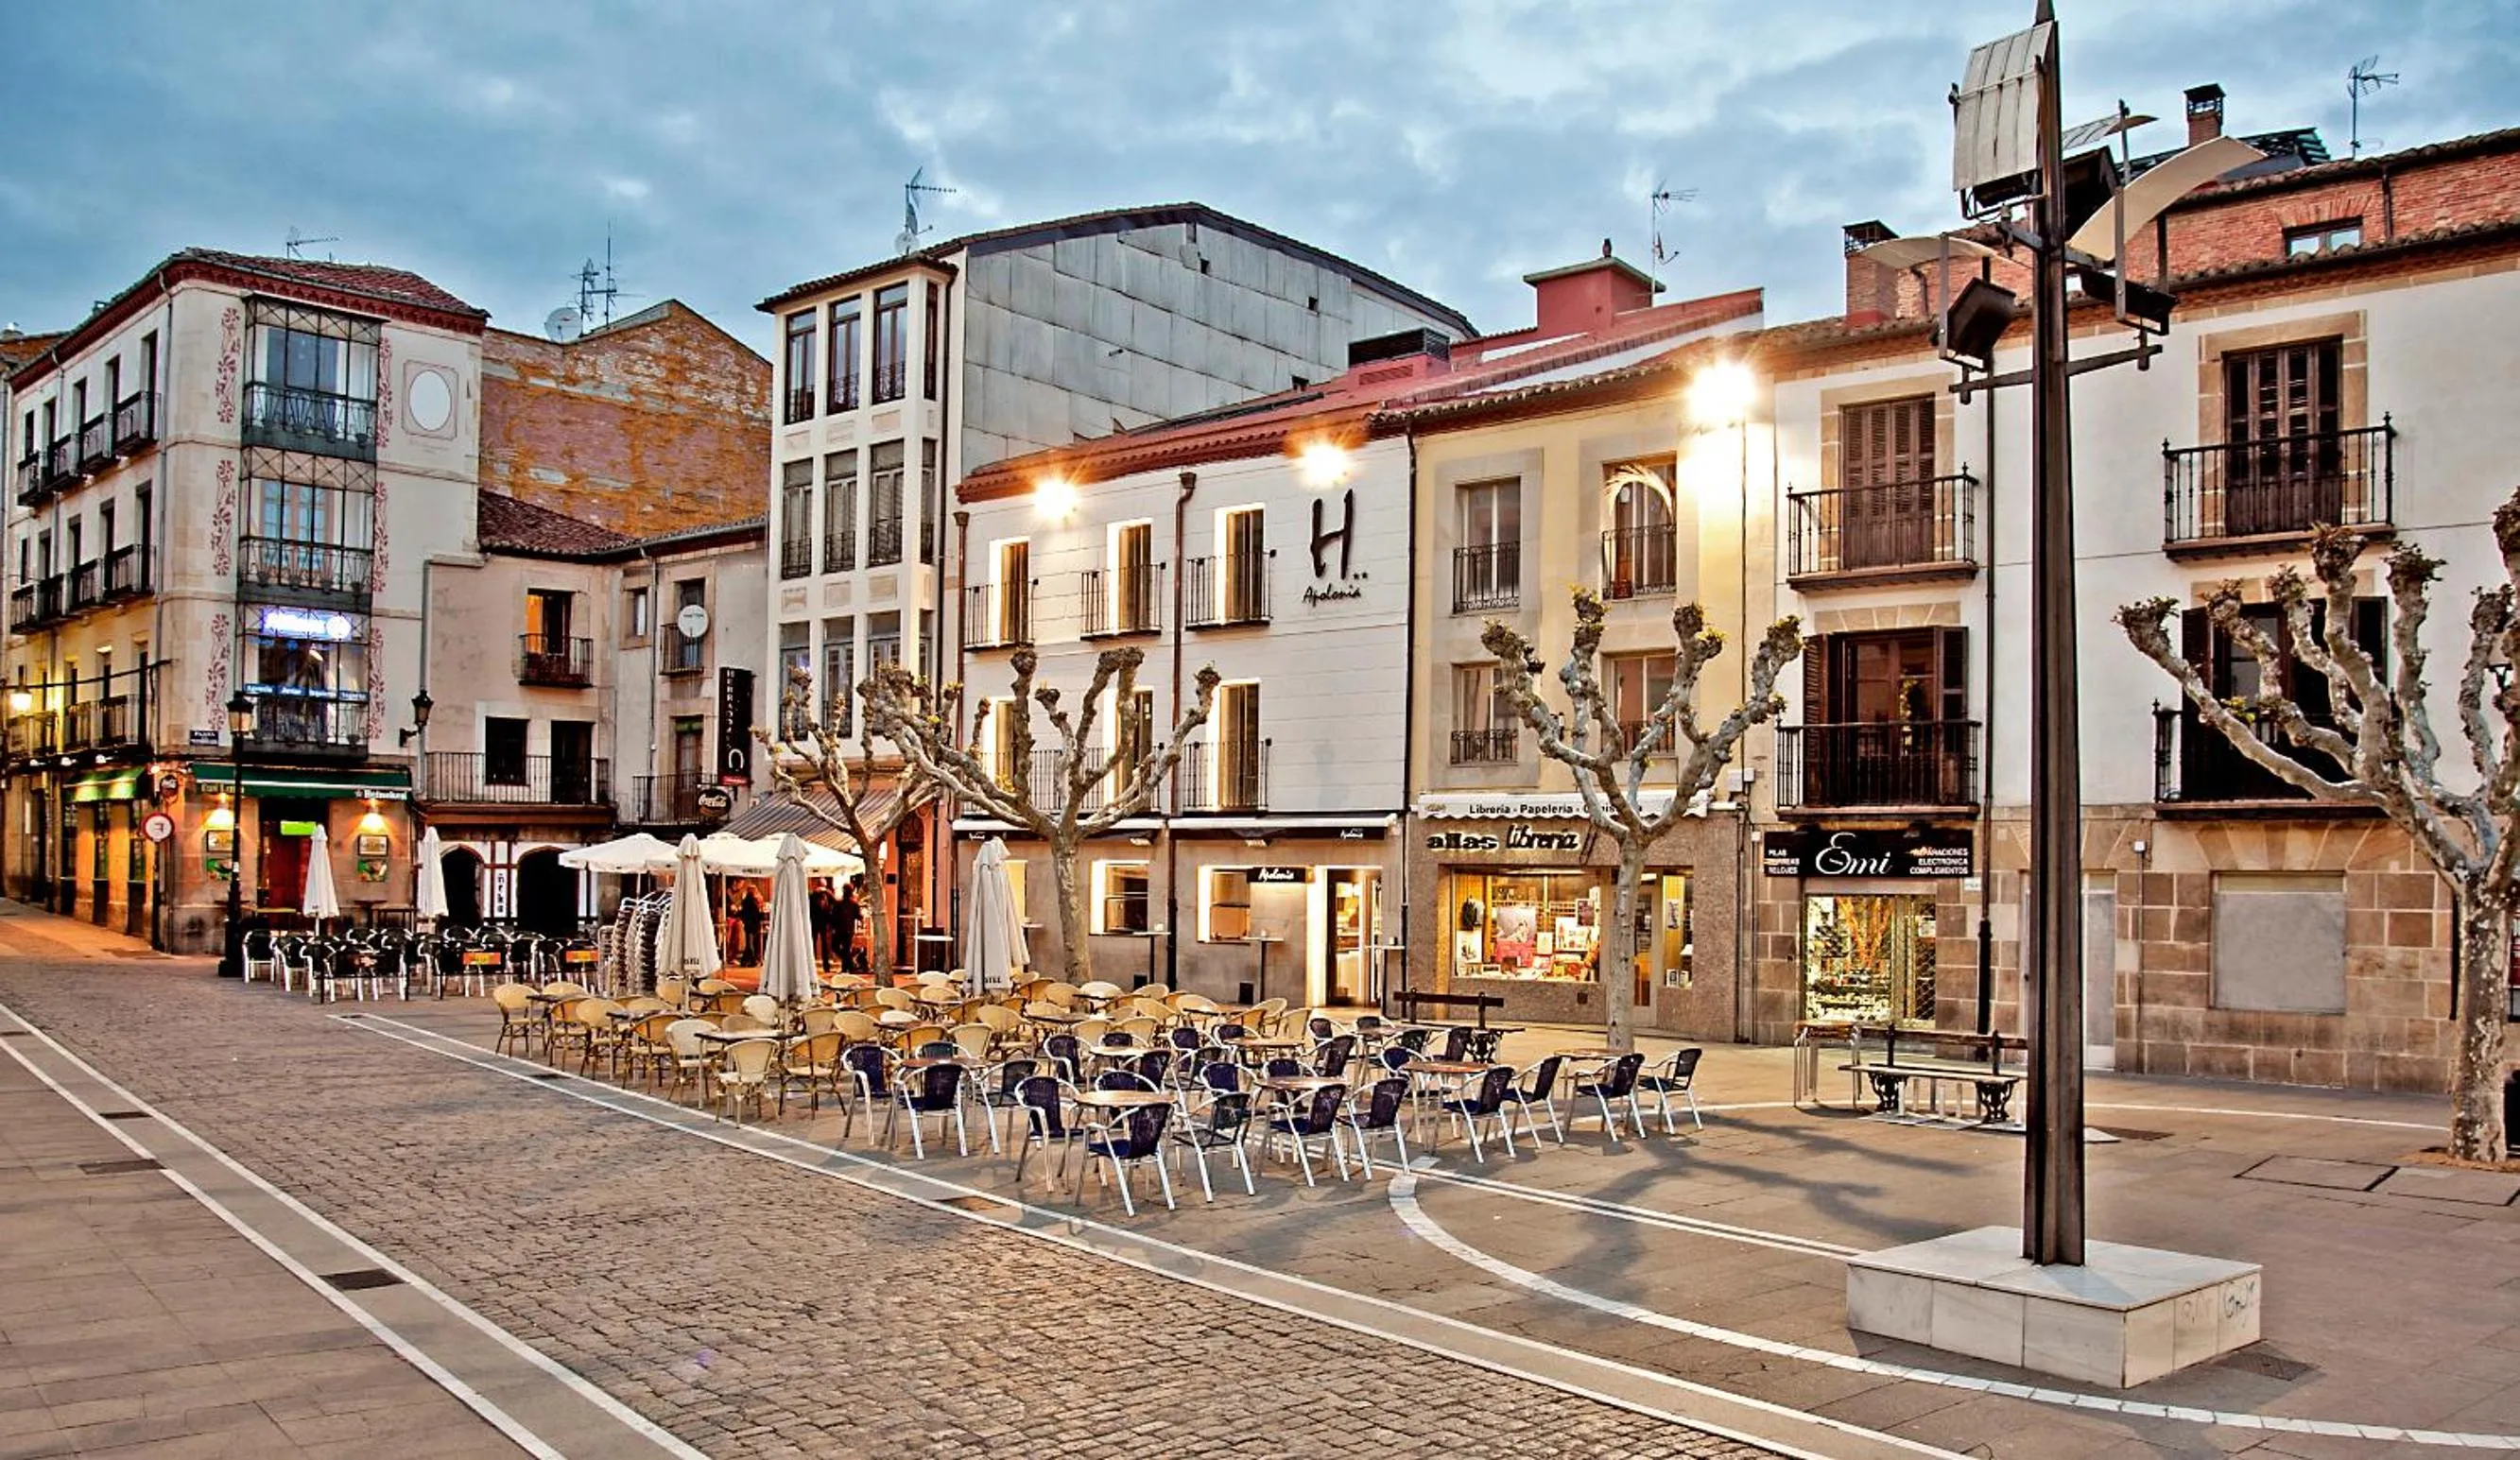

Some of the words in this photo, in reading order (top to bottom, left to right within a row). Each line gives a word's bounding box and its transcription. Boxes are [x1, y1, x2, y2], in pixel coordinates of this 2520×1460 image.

[1303, 583, 1361, 607] Apolonia
[1816, 832, 1893, 875] Emi
[1258, 867, 1295, 881] Apolonia
[1909, 867, 1969, 875] COMPLEMENTOS
